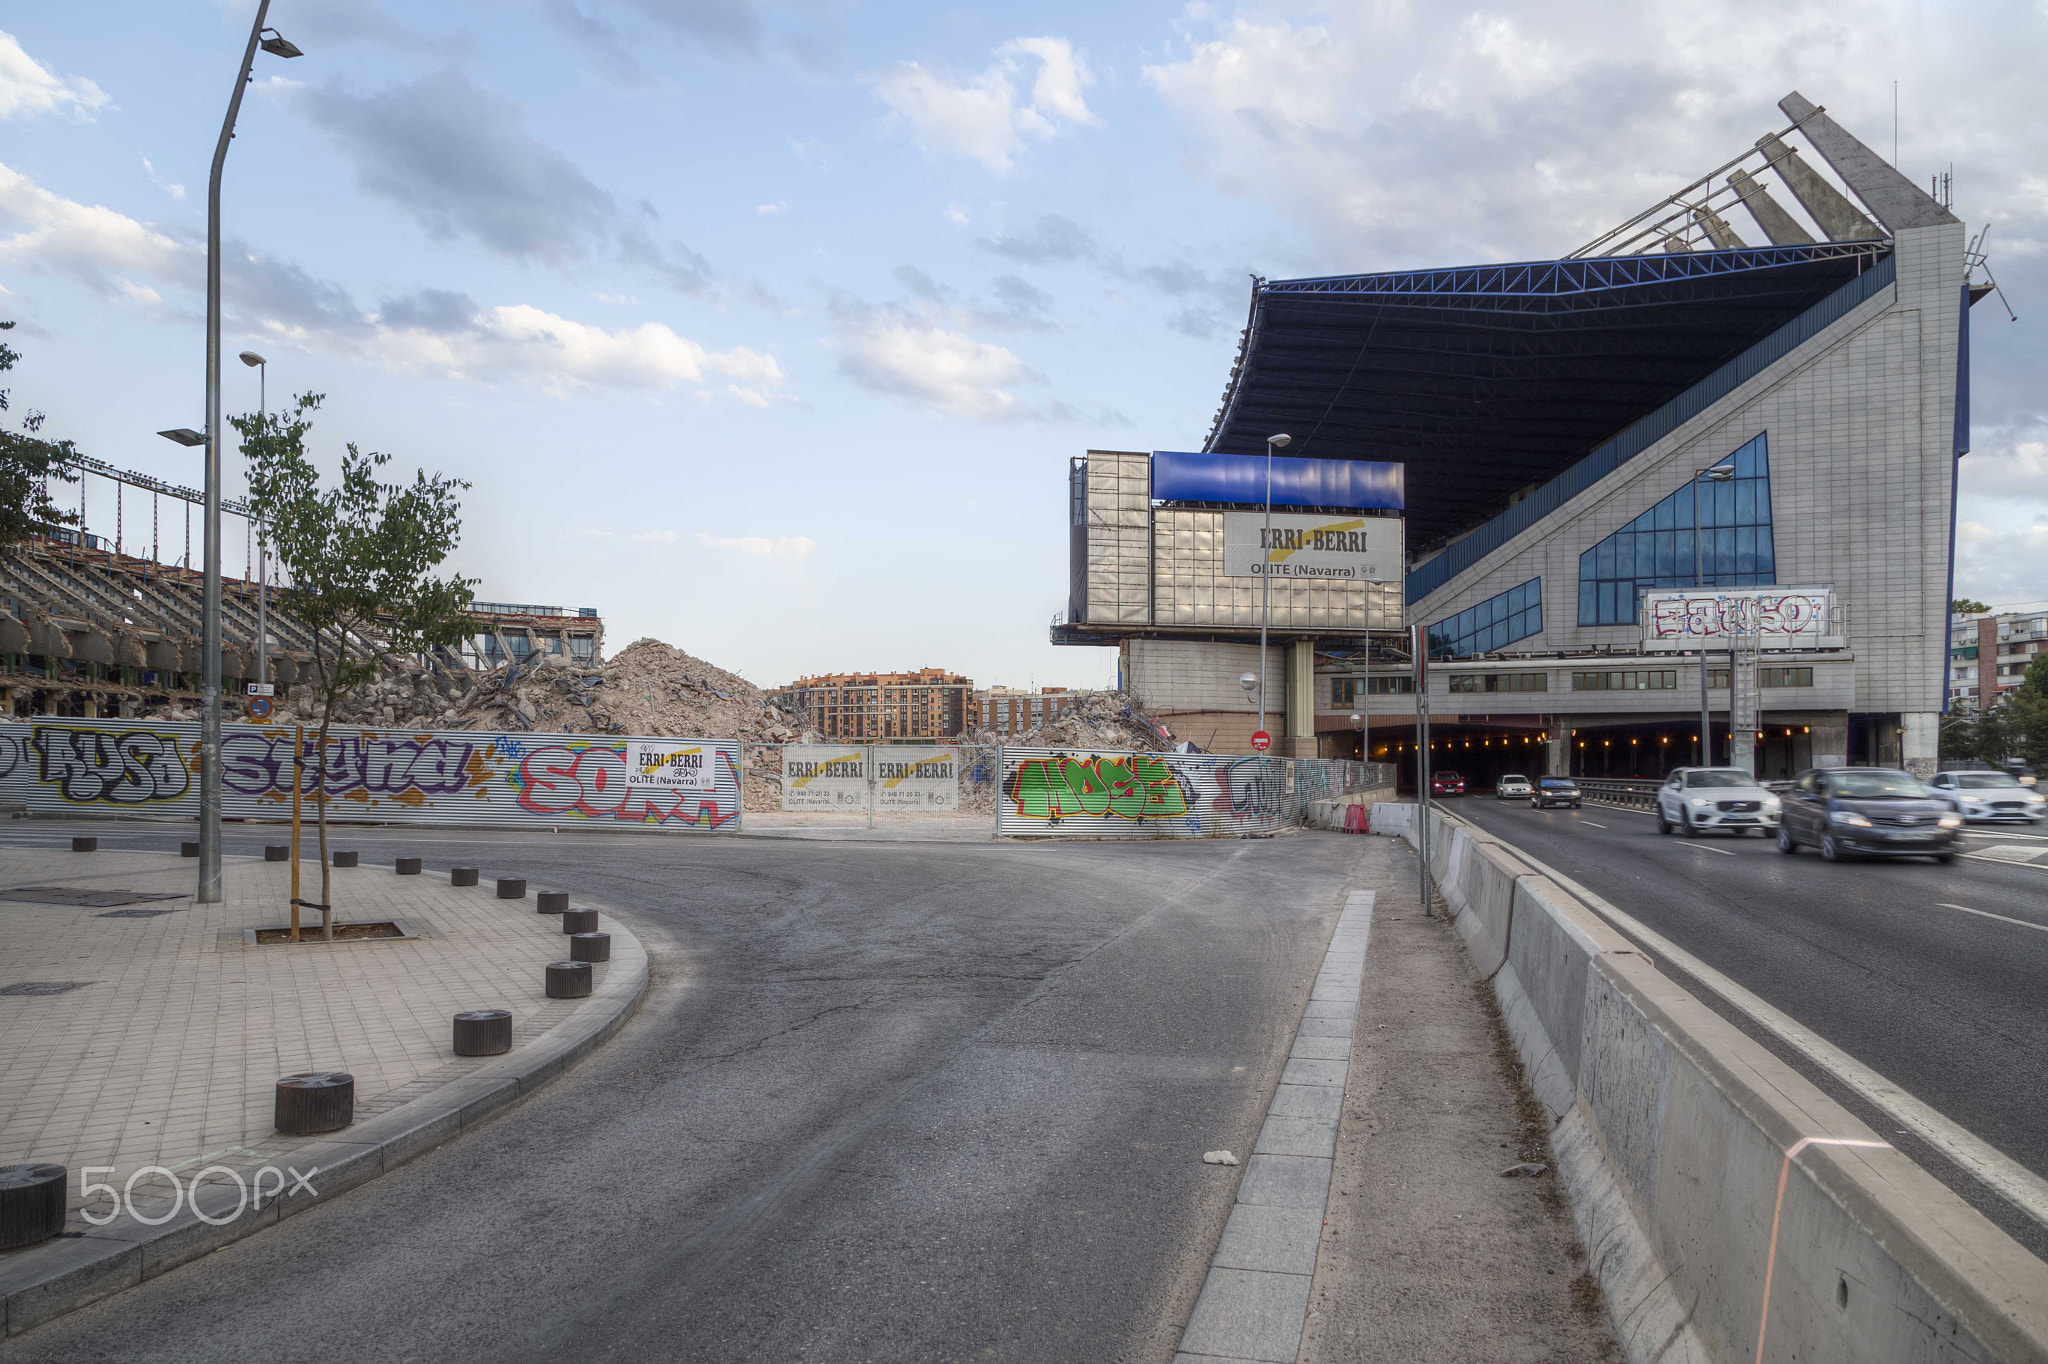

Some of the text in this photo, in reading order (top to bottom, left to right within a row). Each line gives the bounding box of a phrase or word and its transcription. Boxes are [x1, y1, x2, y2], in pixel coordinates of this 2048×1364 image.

[1294, 564, 1356, 577] (Navarra)
[629, 775, 697, 786] OLITE (Navarra)
